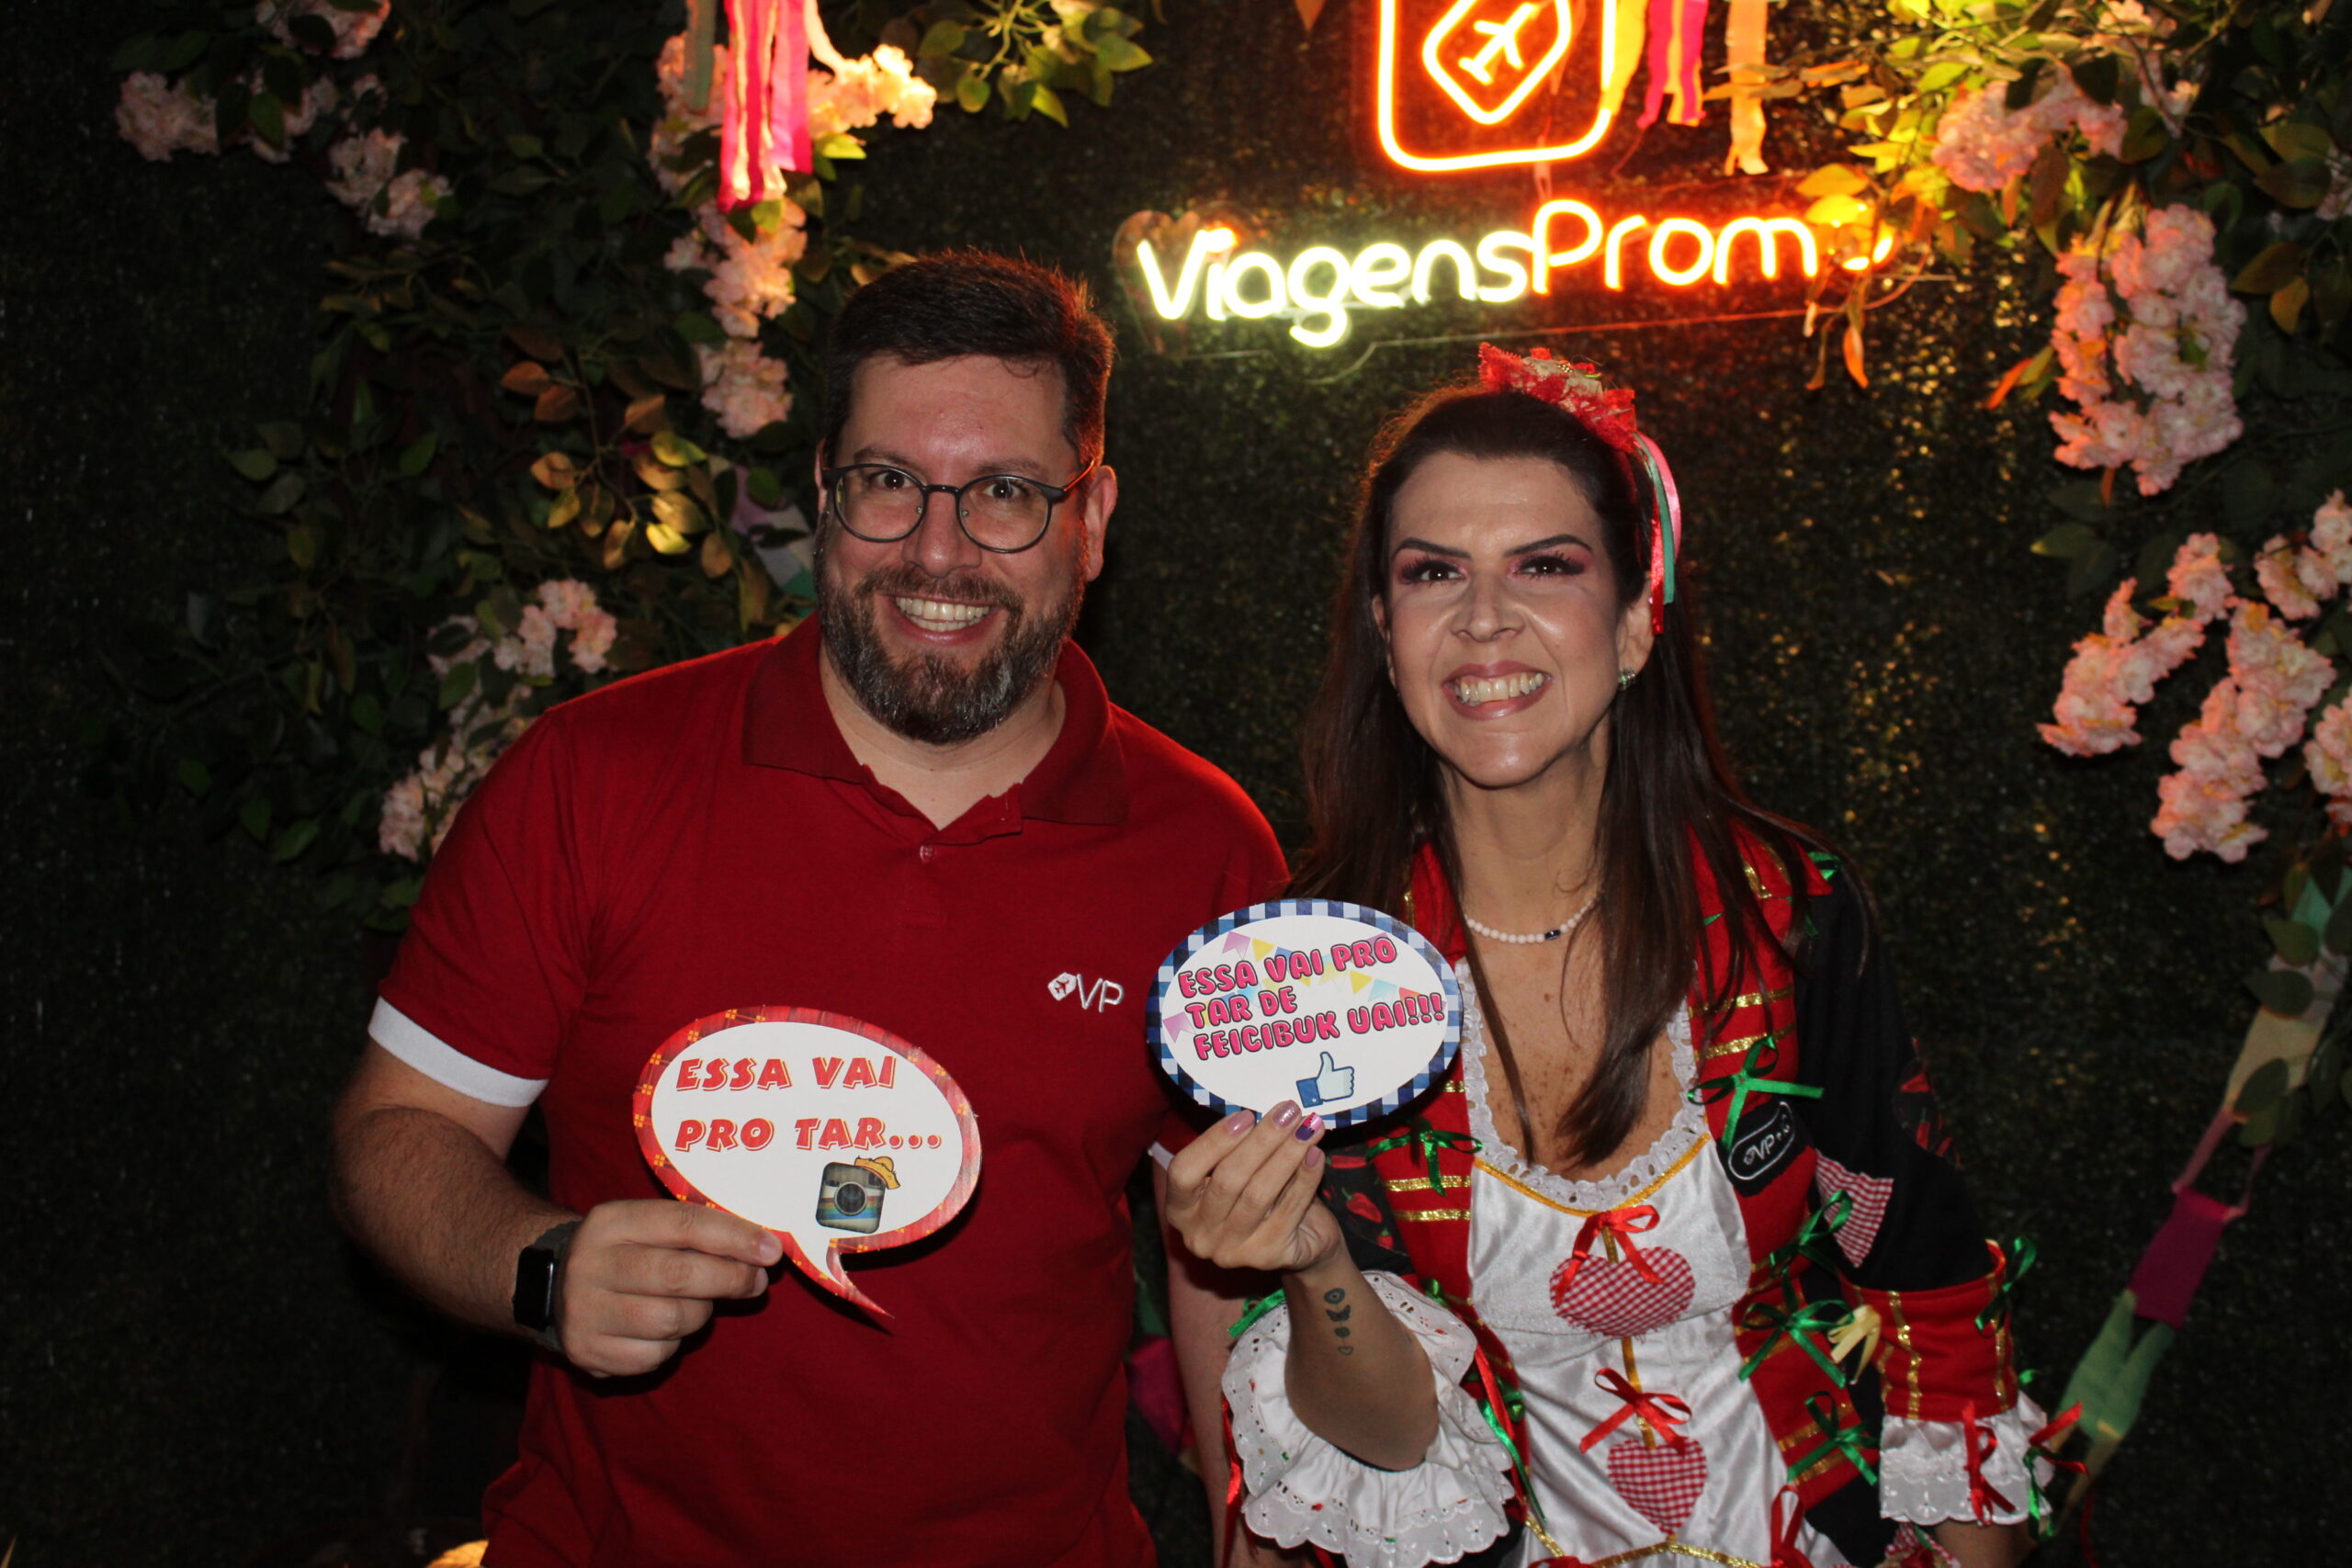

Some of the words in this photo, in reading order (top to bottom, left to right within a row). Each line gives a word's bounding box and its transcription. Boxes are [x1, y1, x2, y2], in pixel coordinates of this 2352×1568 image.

[1178, 961, 1258, 998] ESSA
[1264, 950, 1324, 983] VAI
[1330, 937, 1397, 971] PRO
[1076, 974, 1125, 1012] VP
[1185, 998, 1252, 1030] TAR
[1259, 986, 1297, 1017] DE
[1193, 1010, 1340, 1061] FEICIBUK
[1347, 992, 1445, 1035] UAI!!!
[676, 1058, 792, 1091] ESSA
[812, 1055, 896, 1089] VAI
[675, 1118, 775, 1152] PRO
[794, 1117, 942, 1151] TAR...
